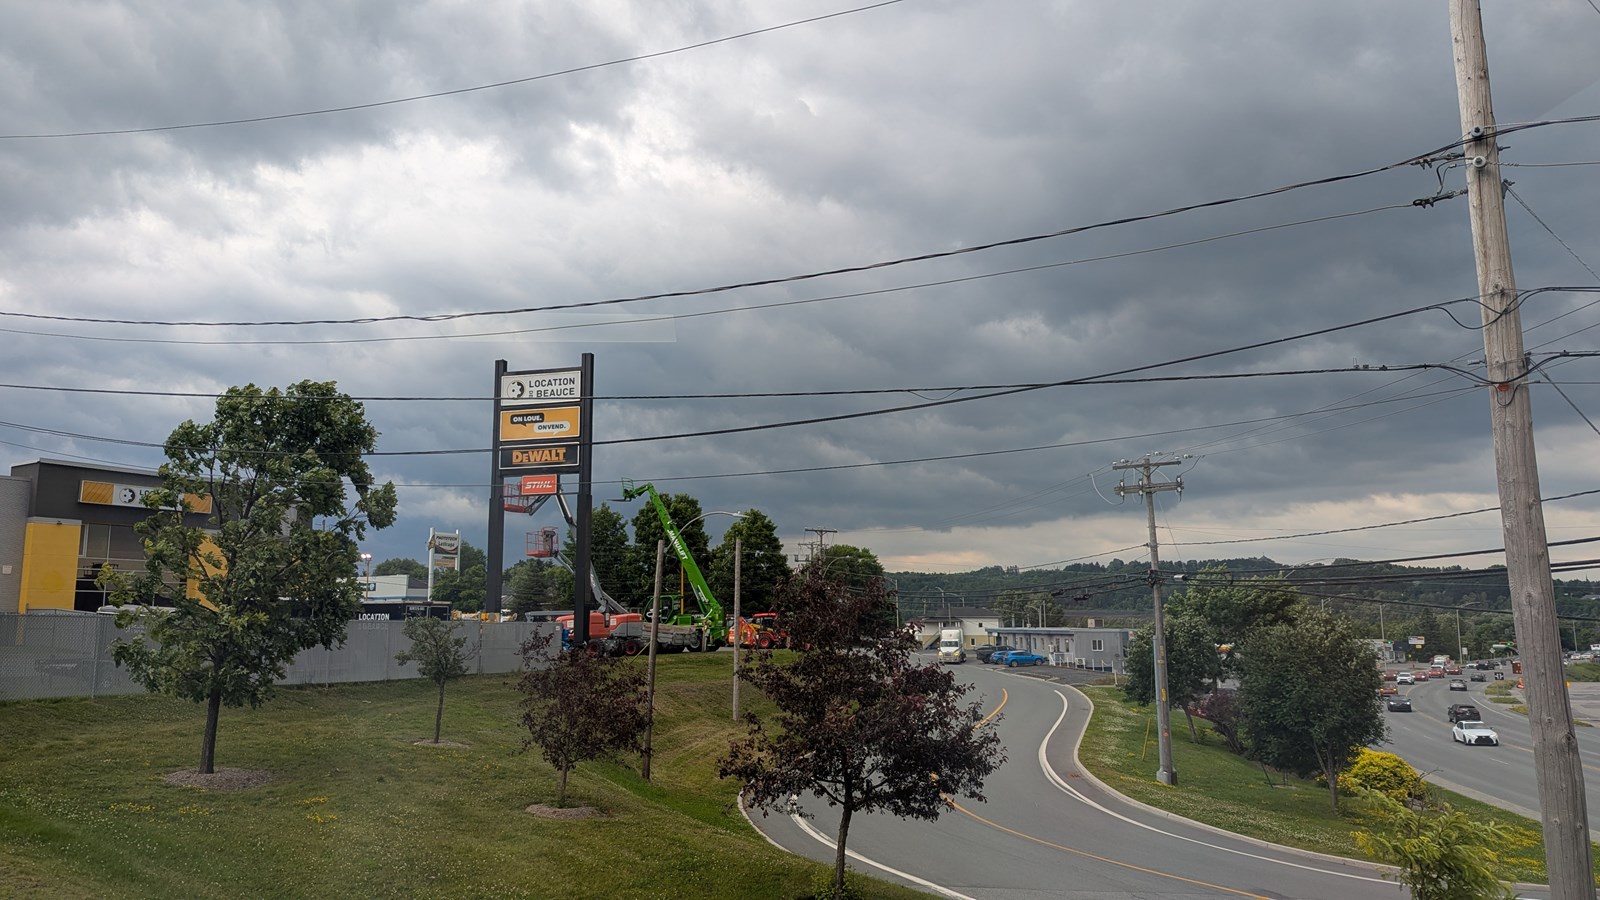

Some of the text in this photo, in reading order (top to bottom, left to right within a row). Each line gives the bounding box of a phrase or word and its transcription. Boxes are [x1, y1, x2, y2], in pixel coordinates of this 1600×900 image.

[529, 377, 575, 387] LOCATION
[536, 388, 575, 398] BEAUCE
[525, 481, 553, 489] STIHL
[358, 613, 390, 621] LOCATION
